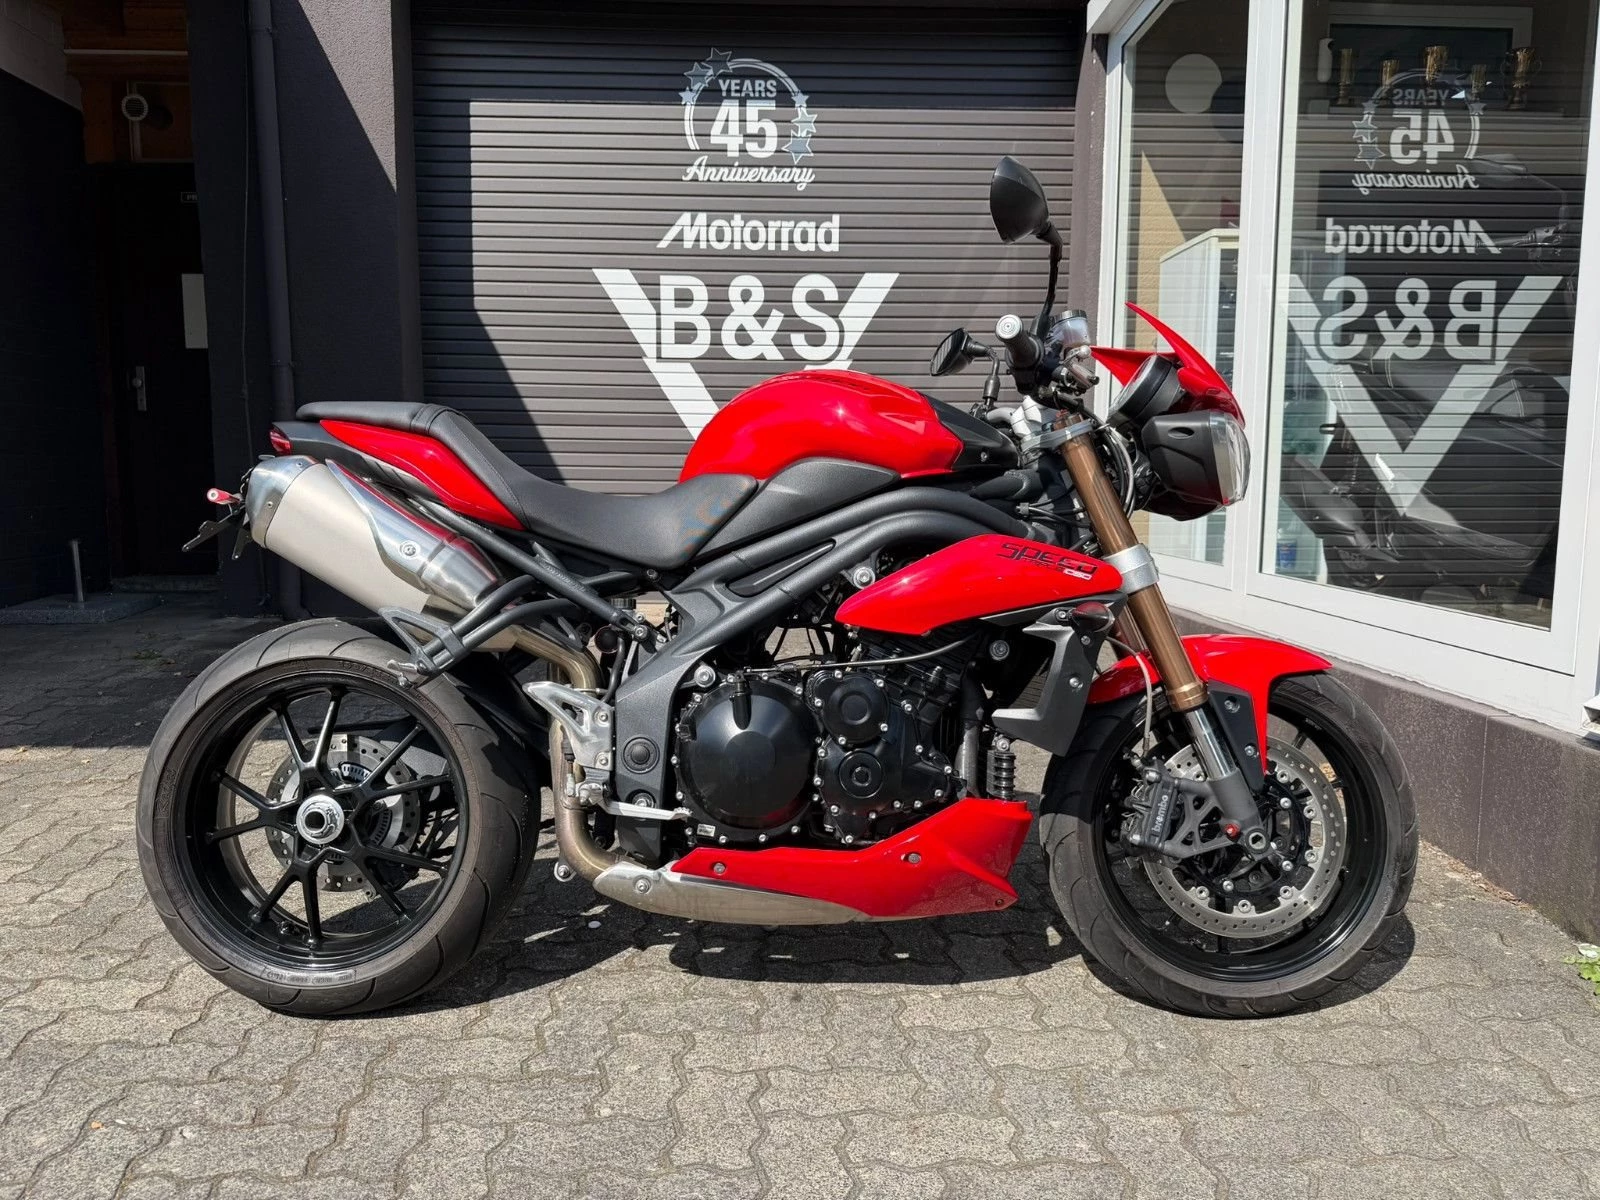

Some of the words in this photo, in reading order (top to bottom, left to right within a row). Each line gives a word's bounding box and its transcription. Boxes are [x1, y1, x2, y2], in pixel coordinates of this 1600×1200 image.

[718, 79, 777, 98] YEARS
[710, 99, 778, 159] 45
[682, 155, 815, 191] Anniversary
[656, 211, 840, 252] Motorrad
[1151, 794, 1169, 833] brembo
